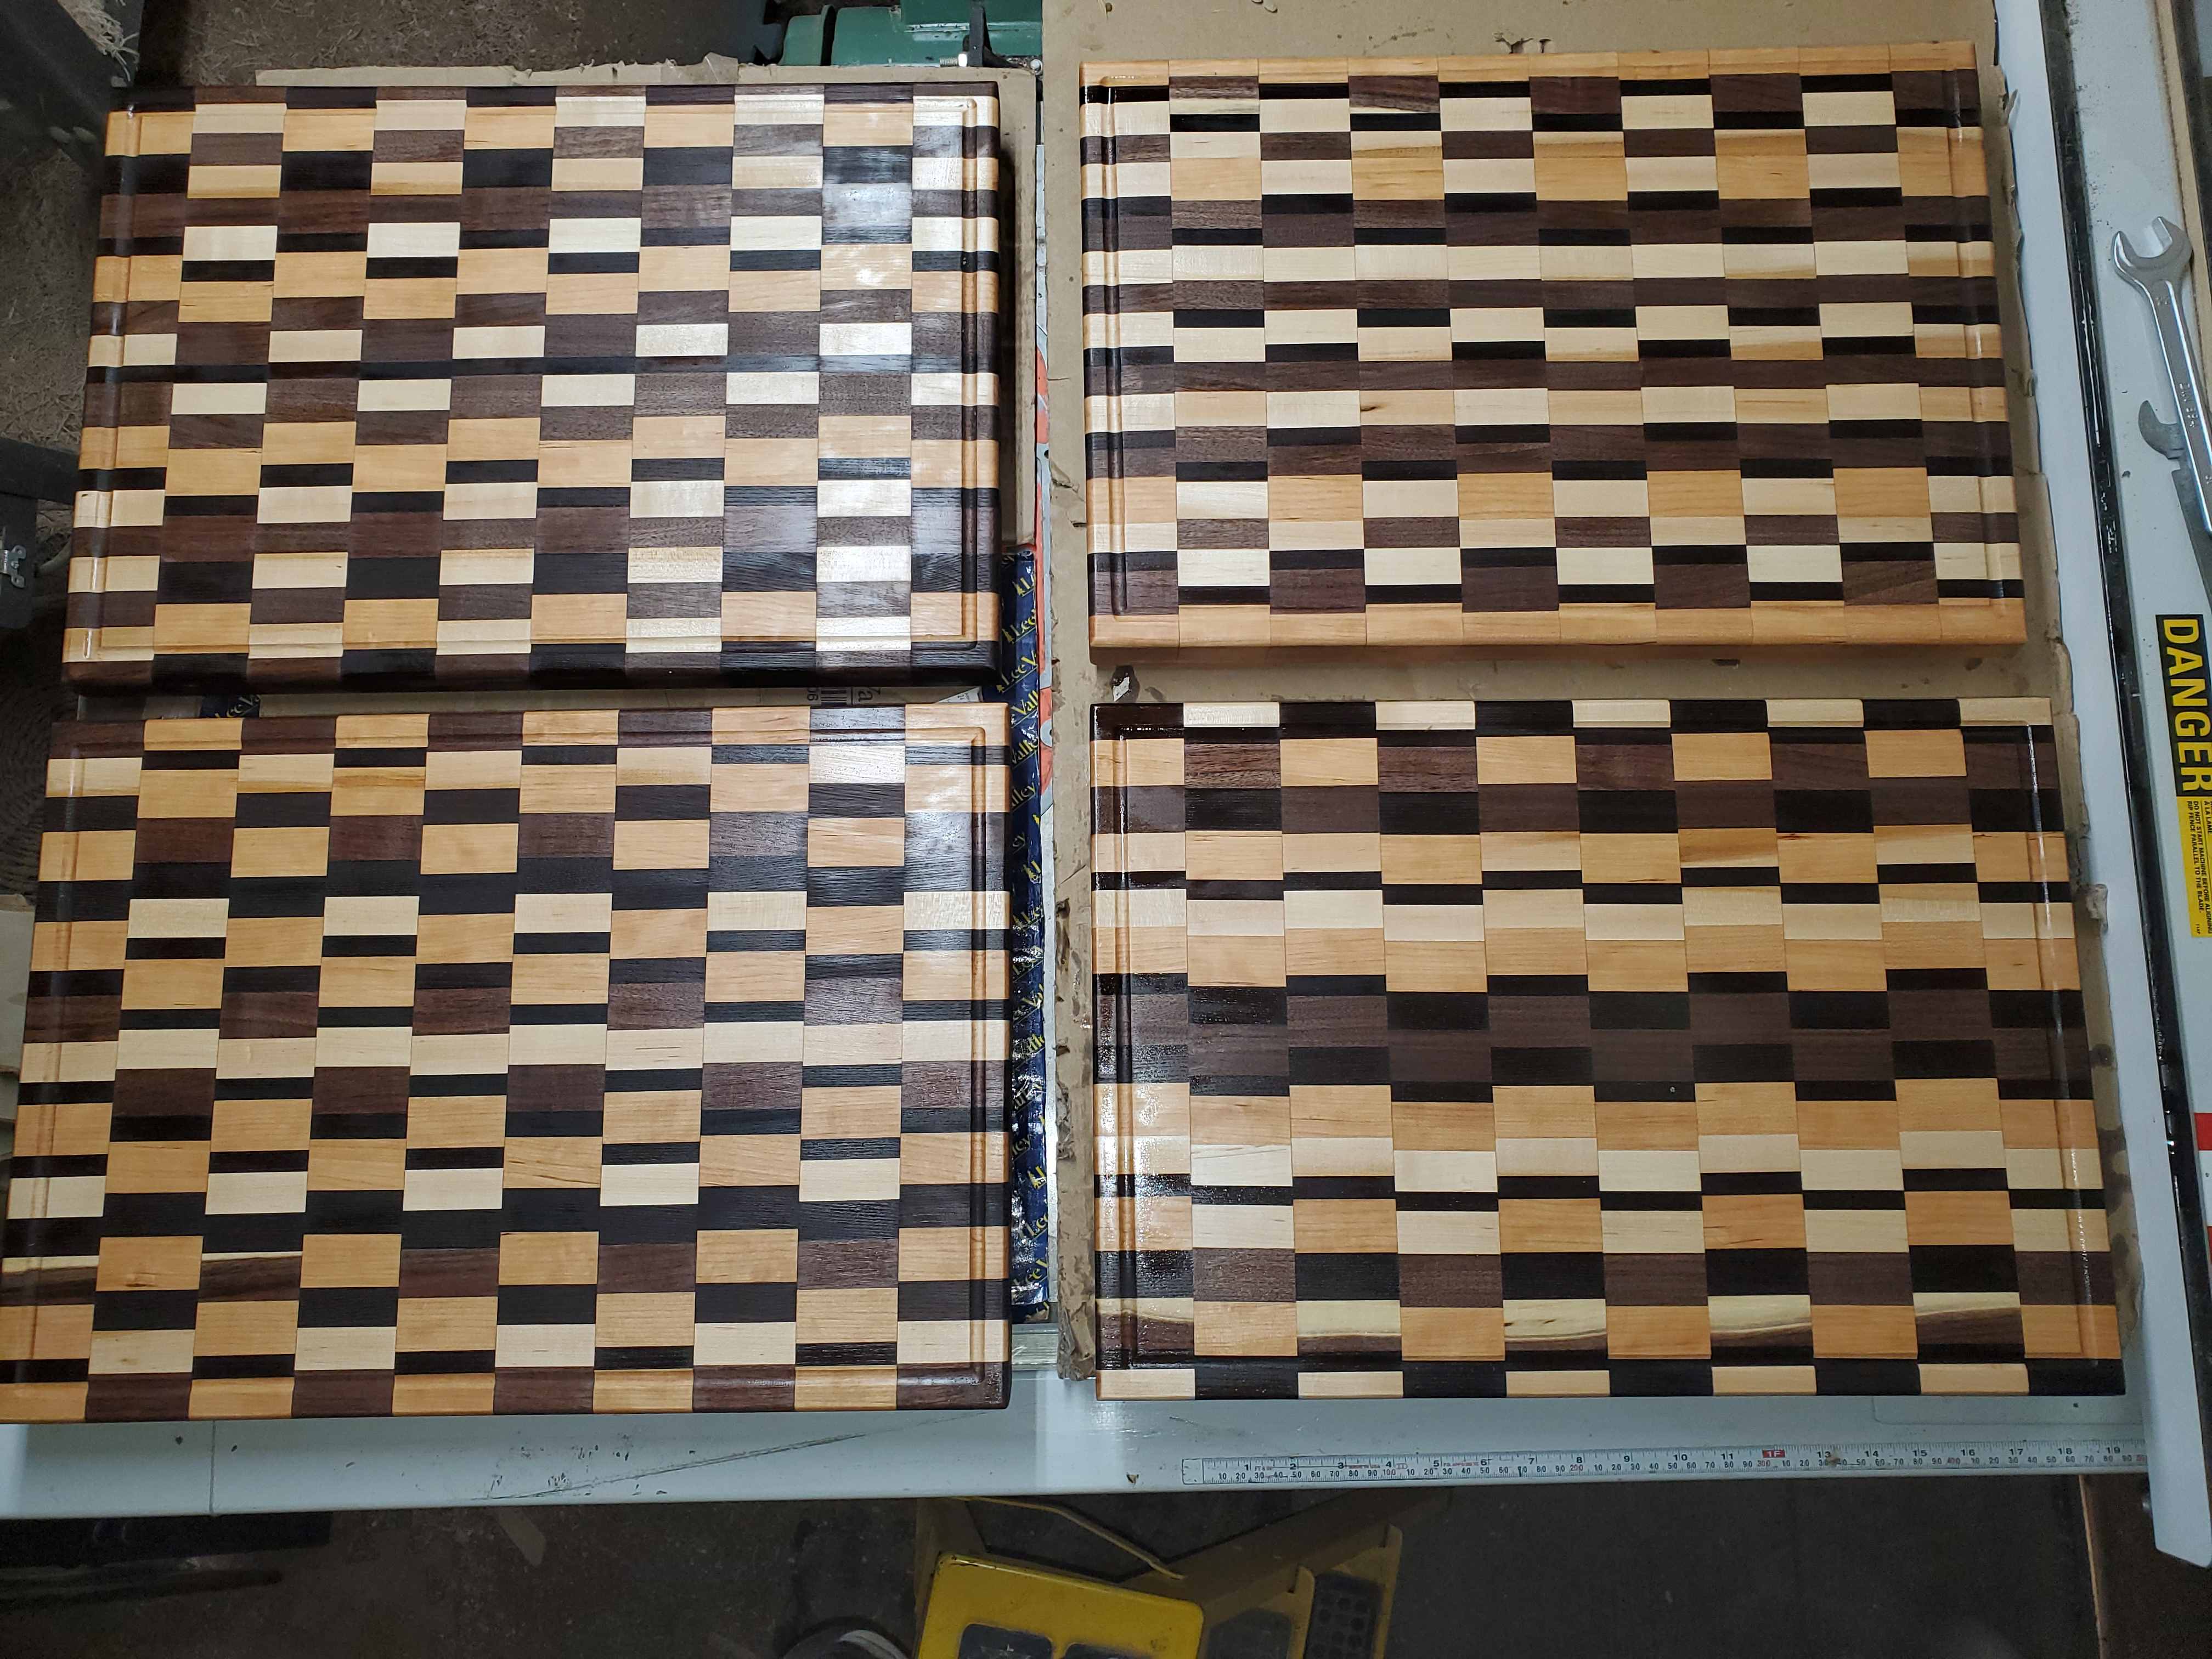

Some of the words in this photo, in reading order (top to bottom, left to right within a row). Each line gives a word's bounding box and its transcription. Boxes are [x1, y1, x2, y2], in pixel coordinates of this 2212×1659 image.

[2164, 619, 2212, 791] DANGER
[2193, 801, 2199, 810] DO
[2191, 834, 2199, 865] PARALLEL
[2194, 867, 2200, 875] TO
